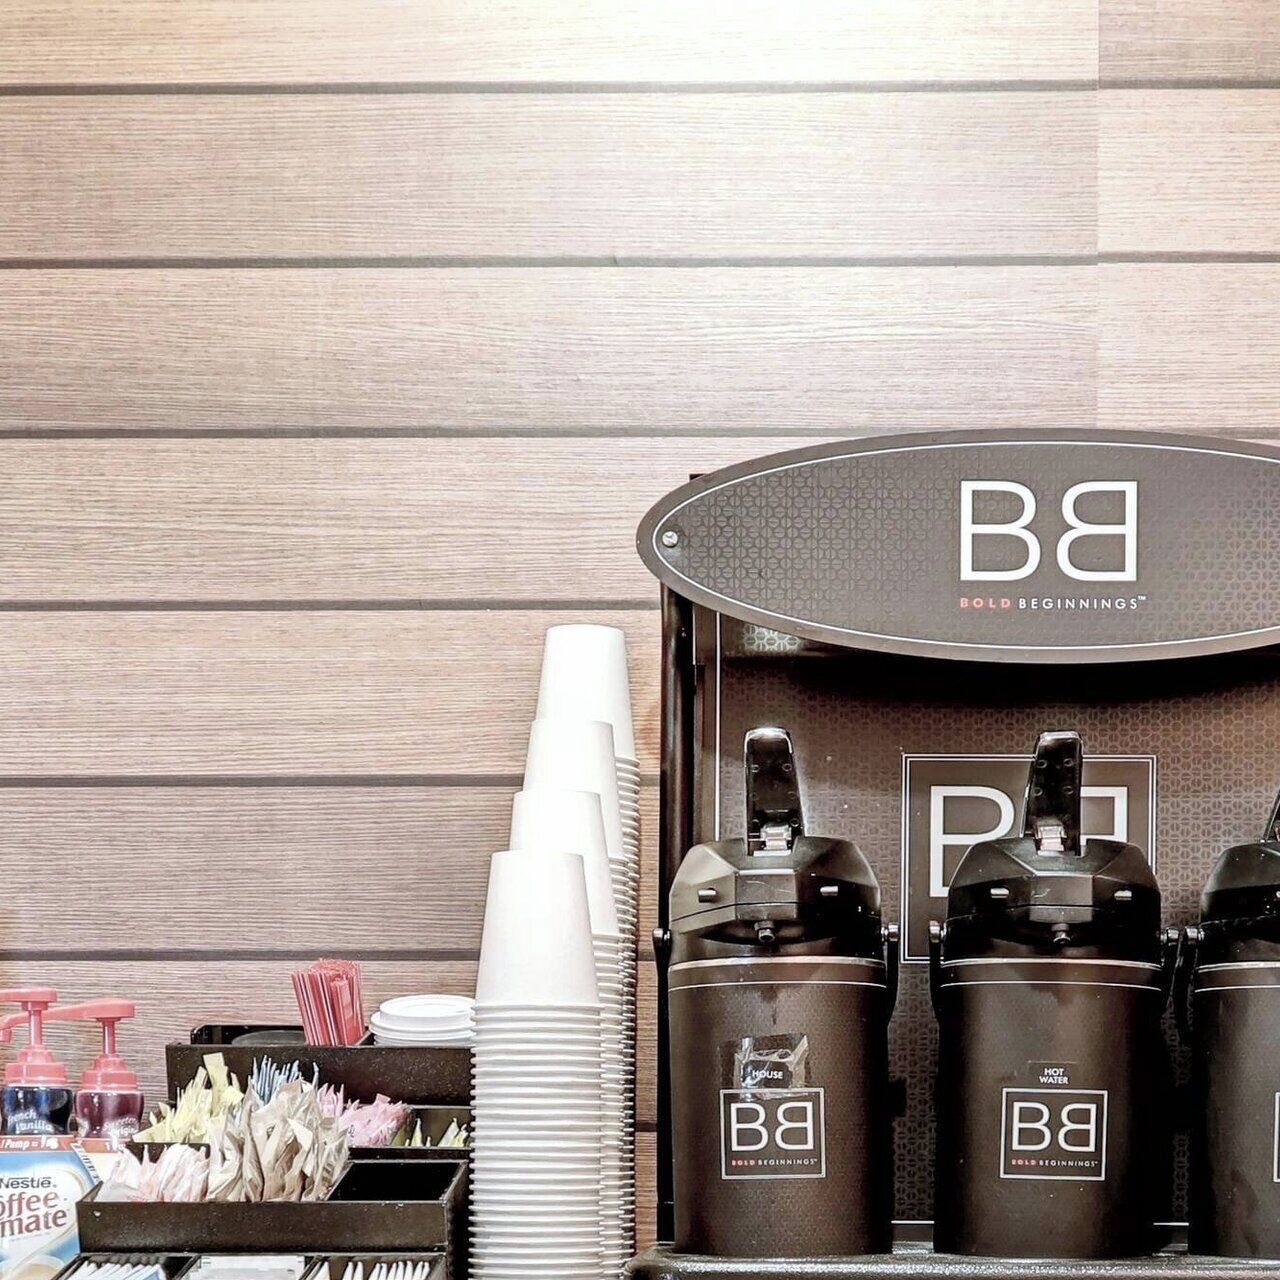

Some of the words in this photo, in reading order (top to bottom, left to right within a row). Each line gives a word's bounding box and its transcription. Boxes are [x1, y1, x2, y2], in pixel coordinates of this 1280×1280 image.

[960, 480, 1137, 581] BB
[960, 597, 1011, 609] BOLD
[752, 1069, 783, 1080] HOUSE
[1044, 1068, 1064, 1076] HOT
[1039, 1076, 1069, 1084] WATER
[5, 1139, 30, 1151] Pump
[0, 1209, 67, 1238] mate
